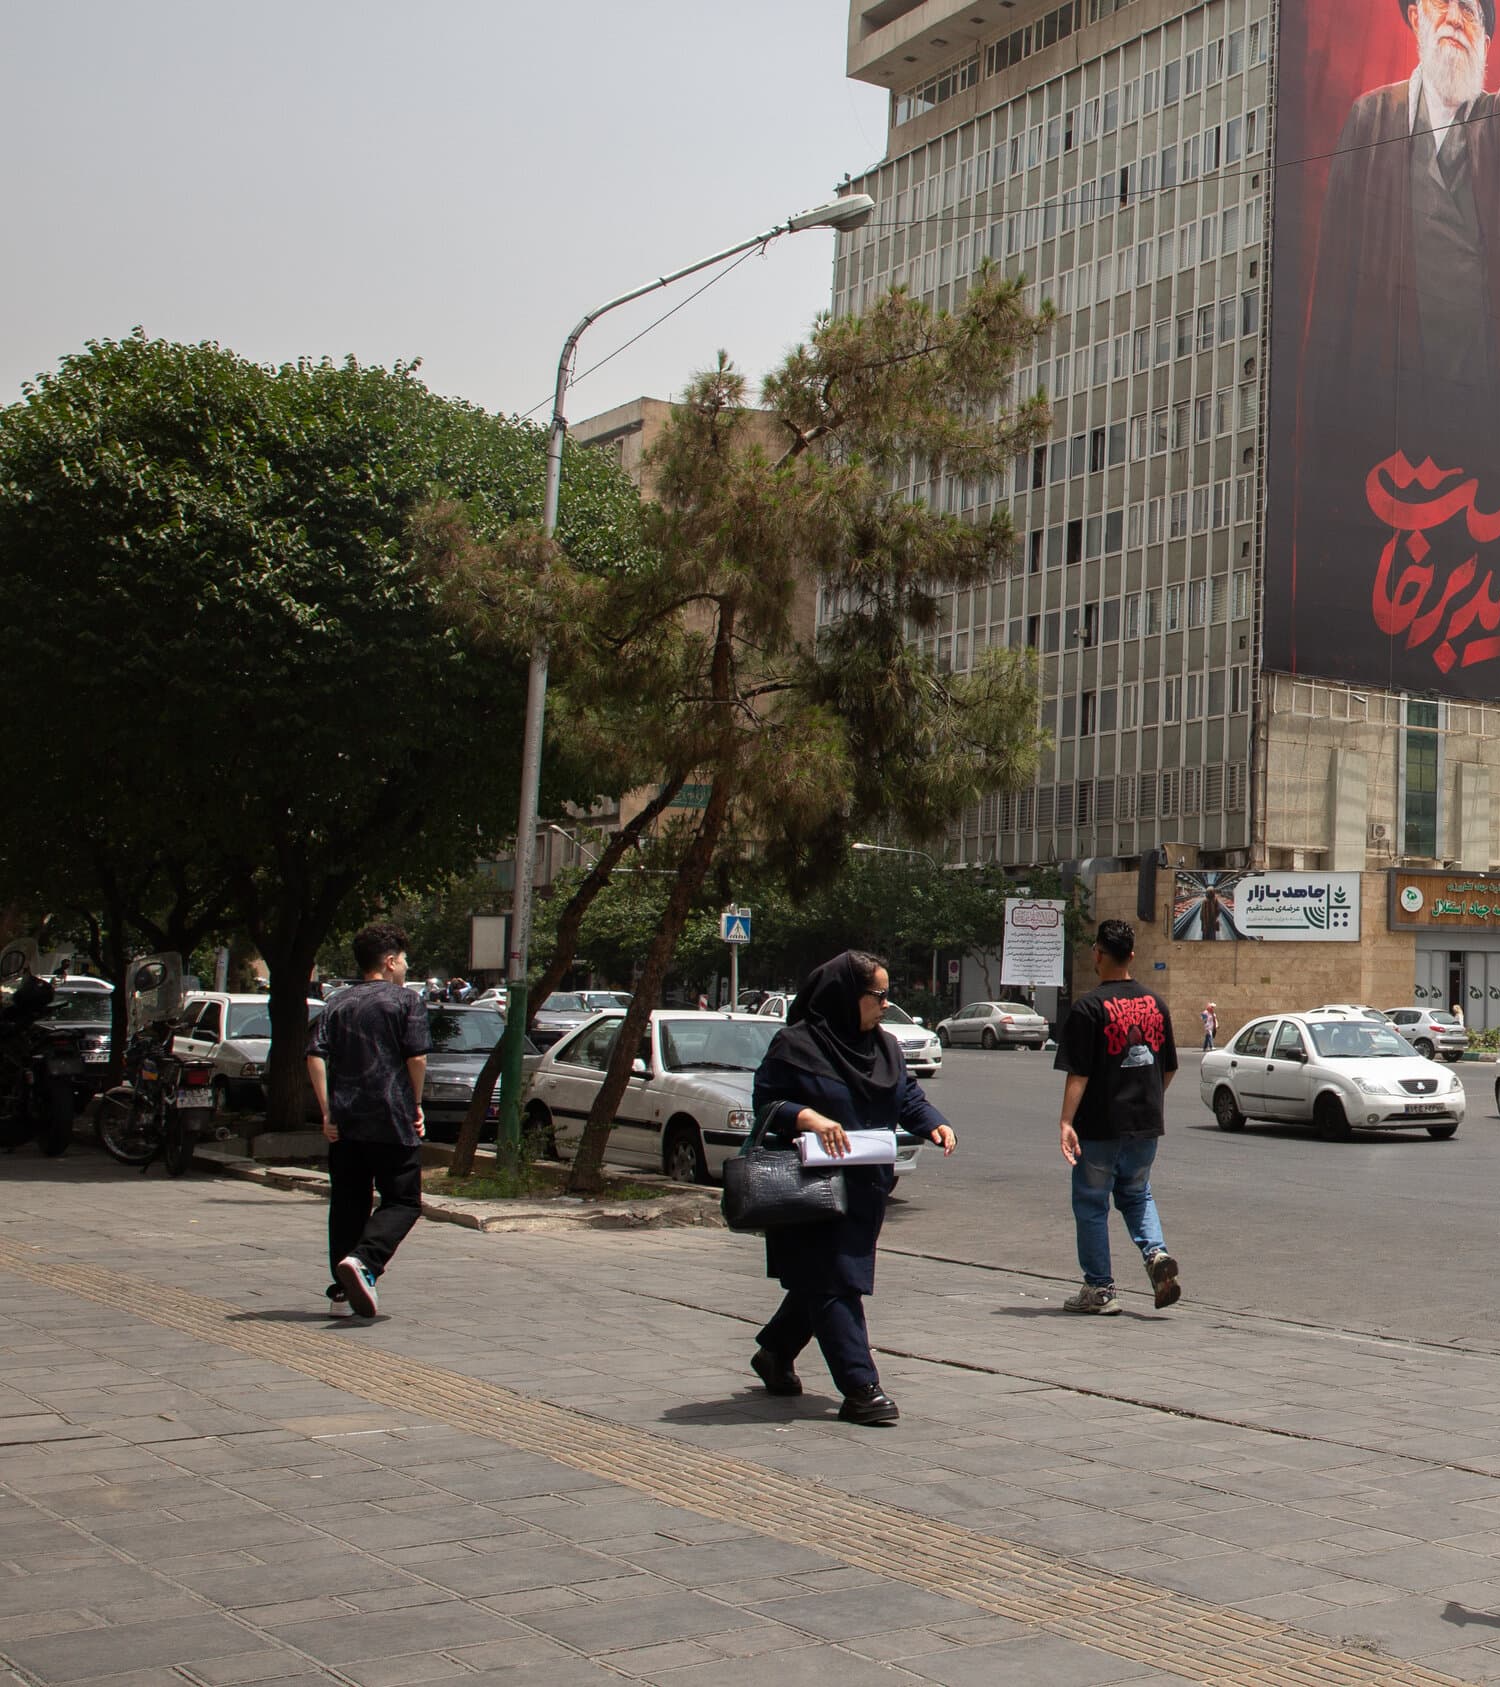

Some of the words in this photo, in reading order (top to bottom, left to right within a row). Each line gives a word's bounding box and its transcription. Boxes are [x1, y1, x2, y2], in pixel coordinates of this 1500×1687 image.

[1247, 885, 1281, 902] بازار
[1282, 885, 1325, 902] جاهد
[1246, 904, 1275, 914] مستقیم
[1432, 898, 1467, 917] استقلال
[1468, 900, 1491, 920] جهاد
[1104, 995, 1160, 1022] NEVER
